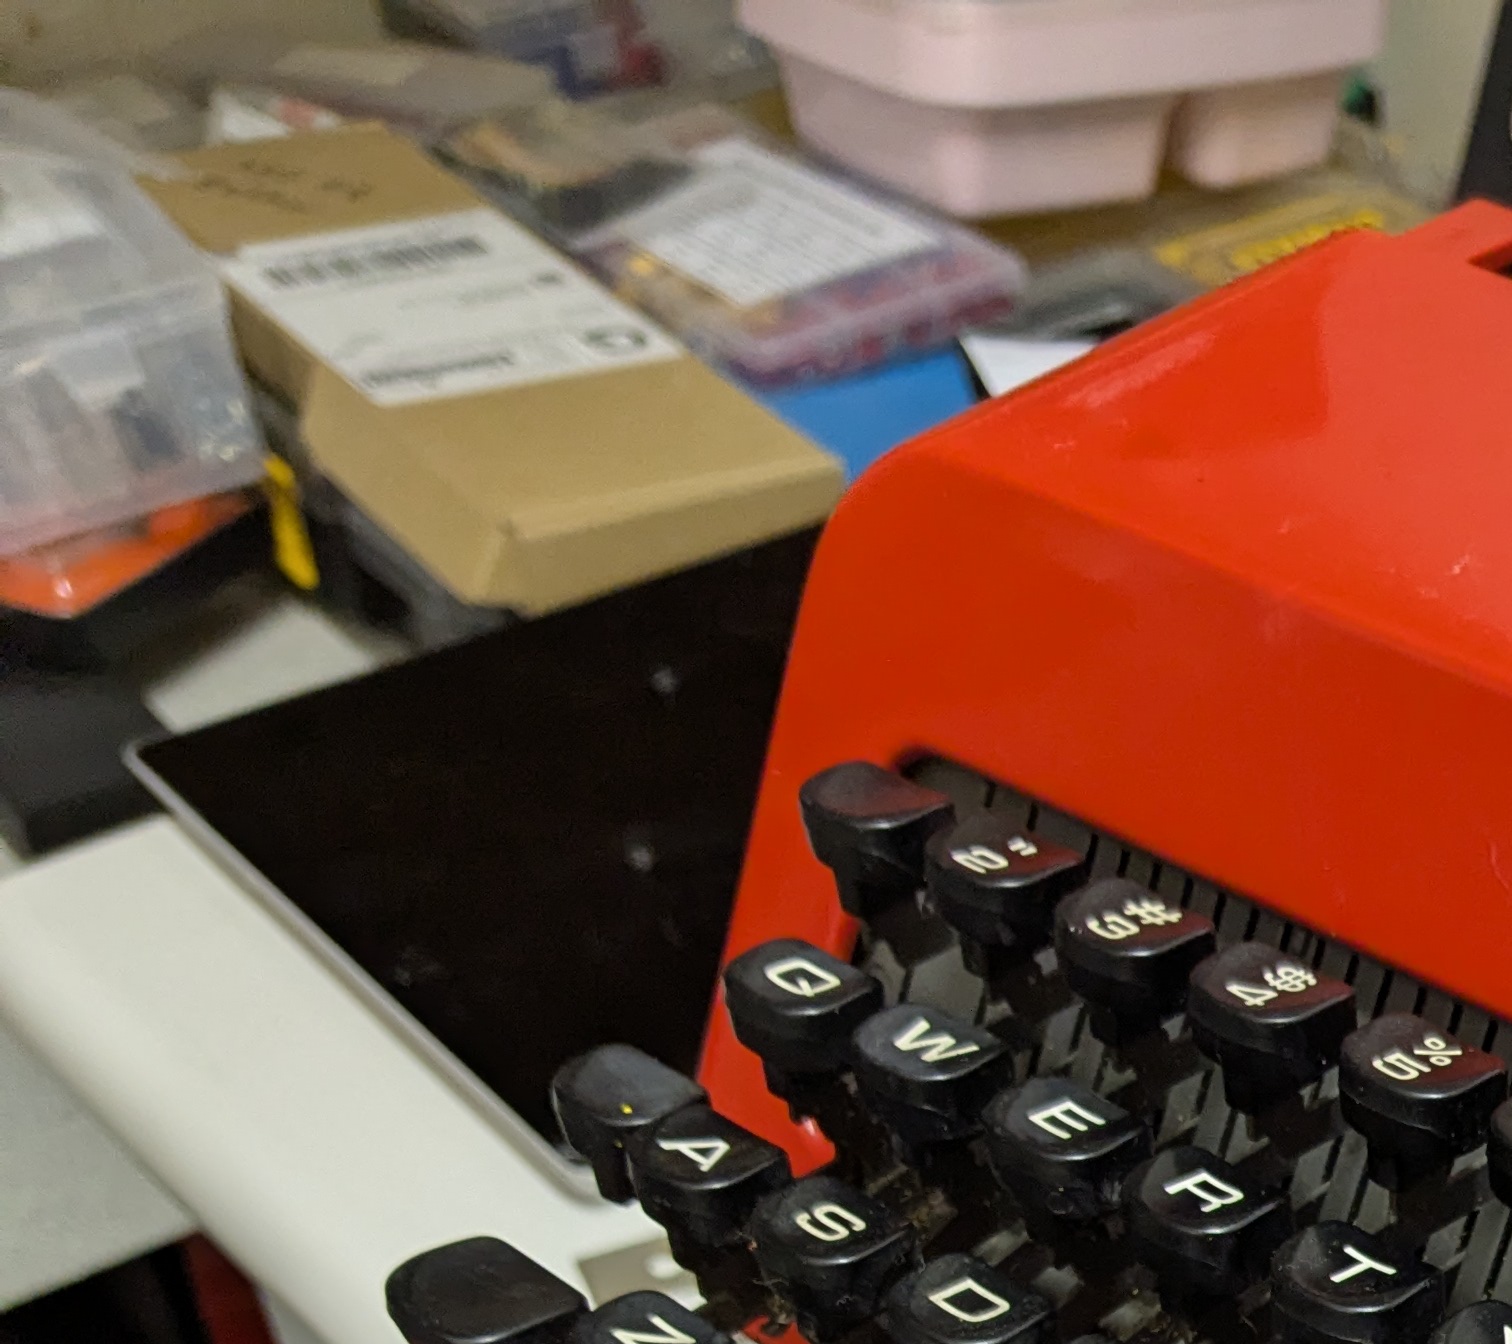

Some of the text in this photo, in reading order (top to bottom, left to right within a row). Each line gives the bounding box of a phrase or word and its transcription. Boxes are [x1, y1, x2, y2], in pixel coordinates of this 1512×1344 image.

[950, 844, 1010, 875] 2
[1084, 910, 1141, 941] 3
[763, 956, 842, 998] Q
[1224, 981, 1279, 1007] 4
[892, 1016, 981, 1063] W
[1412, 1035, 1464, 1068] %
[1370, 1048, 1433, 1082] 5
[1026, 1098, 1107, 1140] E
[656, 1137, 731, 1173] A
[1162, 1169, 1245, 1214] R
[792, 1201, 867, 1243] S
[1328, 1244, 1398, 1284] T
[926, 1275, 1011, 1324] D
